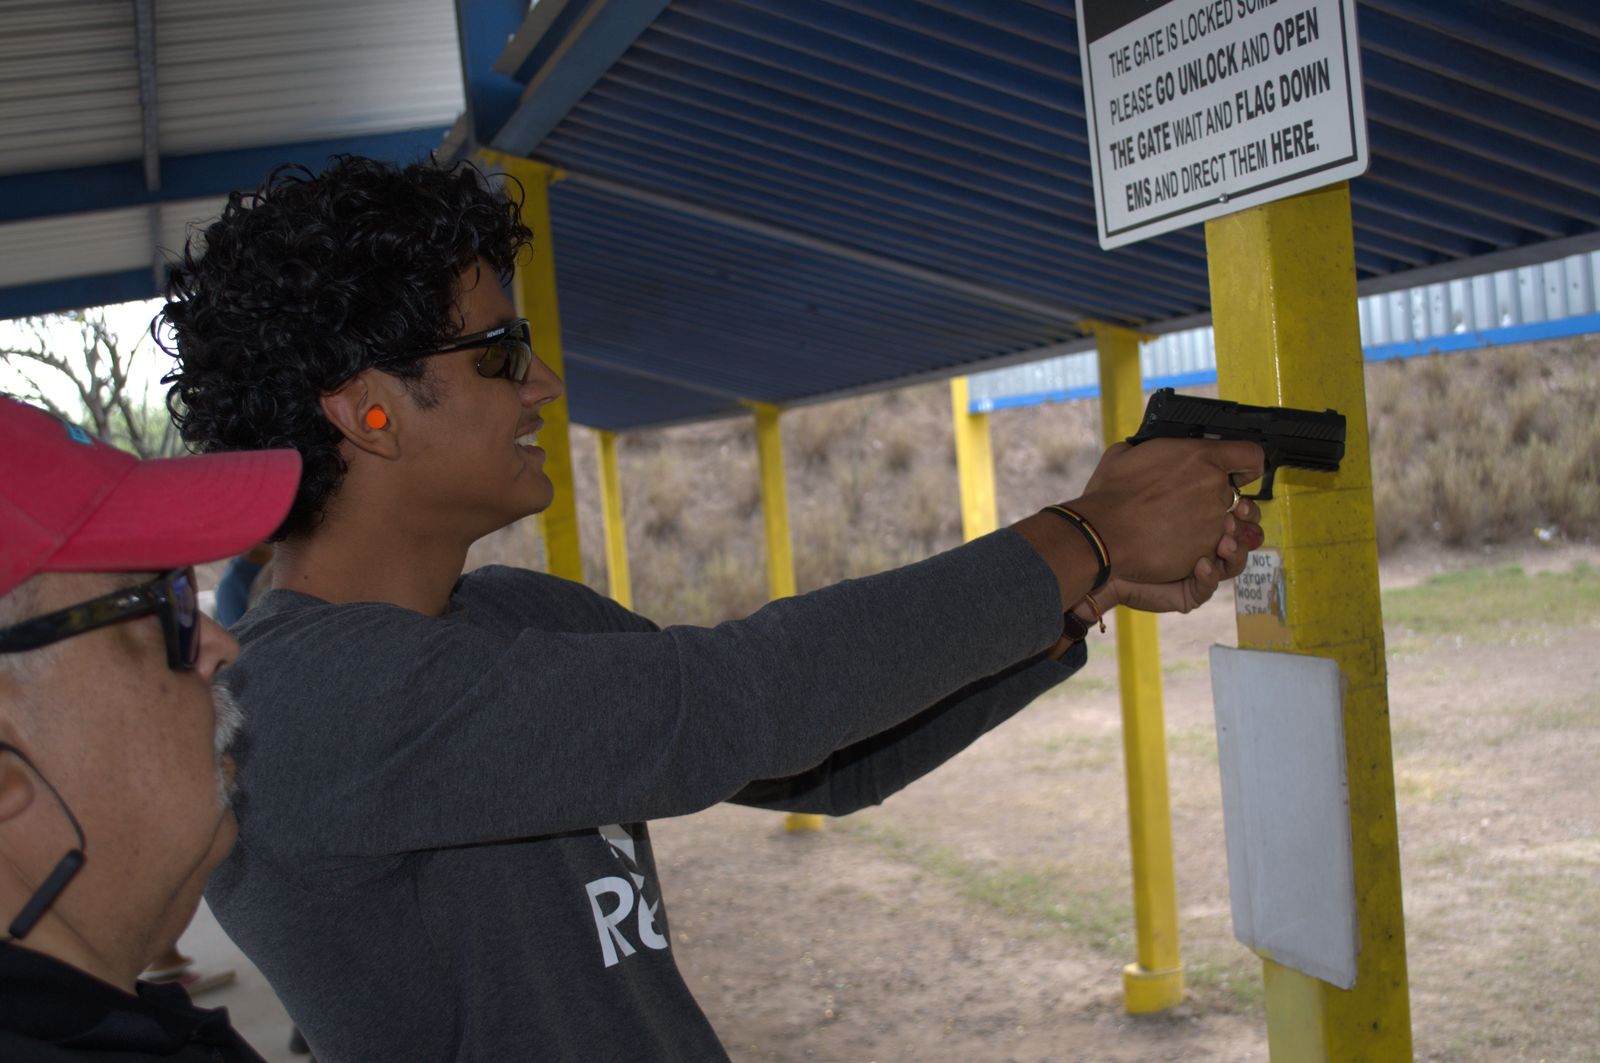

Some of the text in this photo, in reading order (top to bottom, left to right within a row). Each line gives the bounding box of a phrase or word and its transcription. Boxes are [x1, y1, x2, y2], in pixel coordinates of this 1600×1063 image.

[1109, 0, 1278, 78] THE GATE IS LOCKED SO
[1110, 6, 1319, 125] PLEASE GO UNLOCK AND OPEN
[1110, 57, 1331, 170] THE GATE WAIT AND FLAG DOWN
[1125, 119, 1320, 212] EMS AND DIRECT THEM HERE.
[1252, 554, 1272, 567] Not
